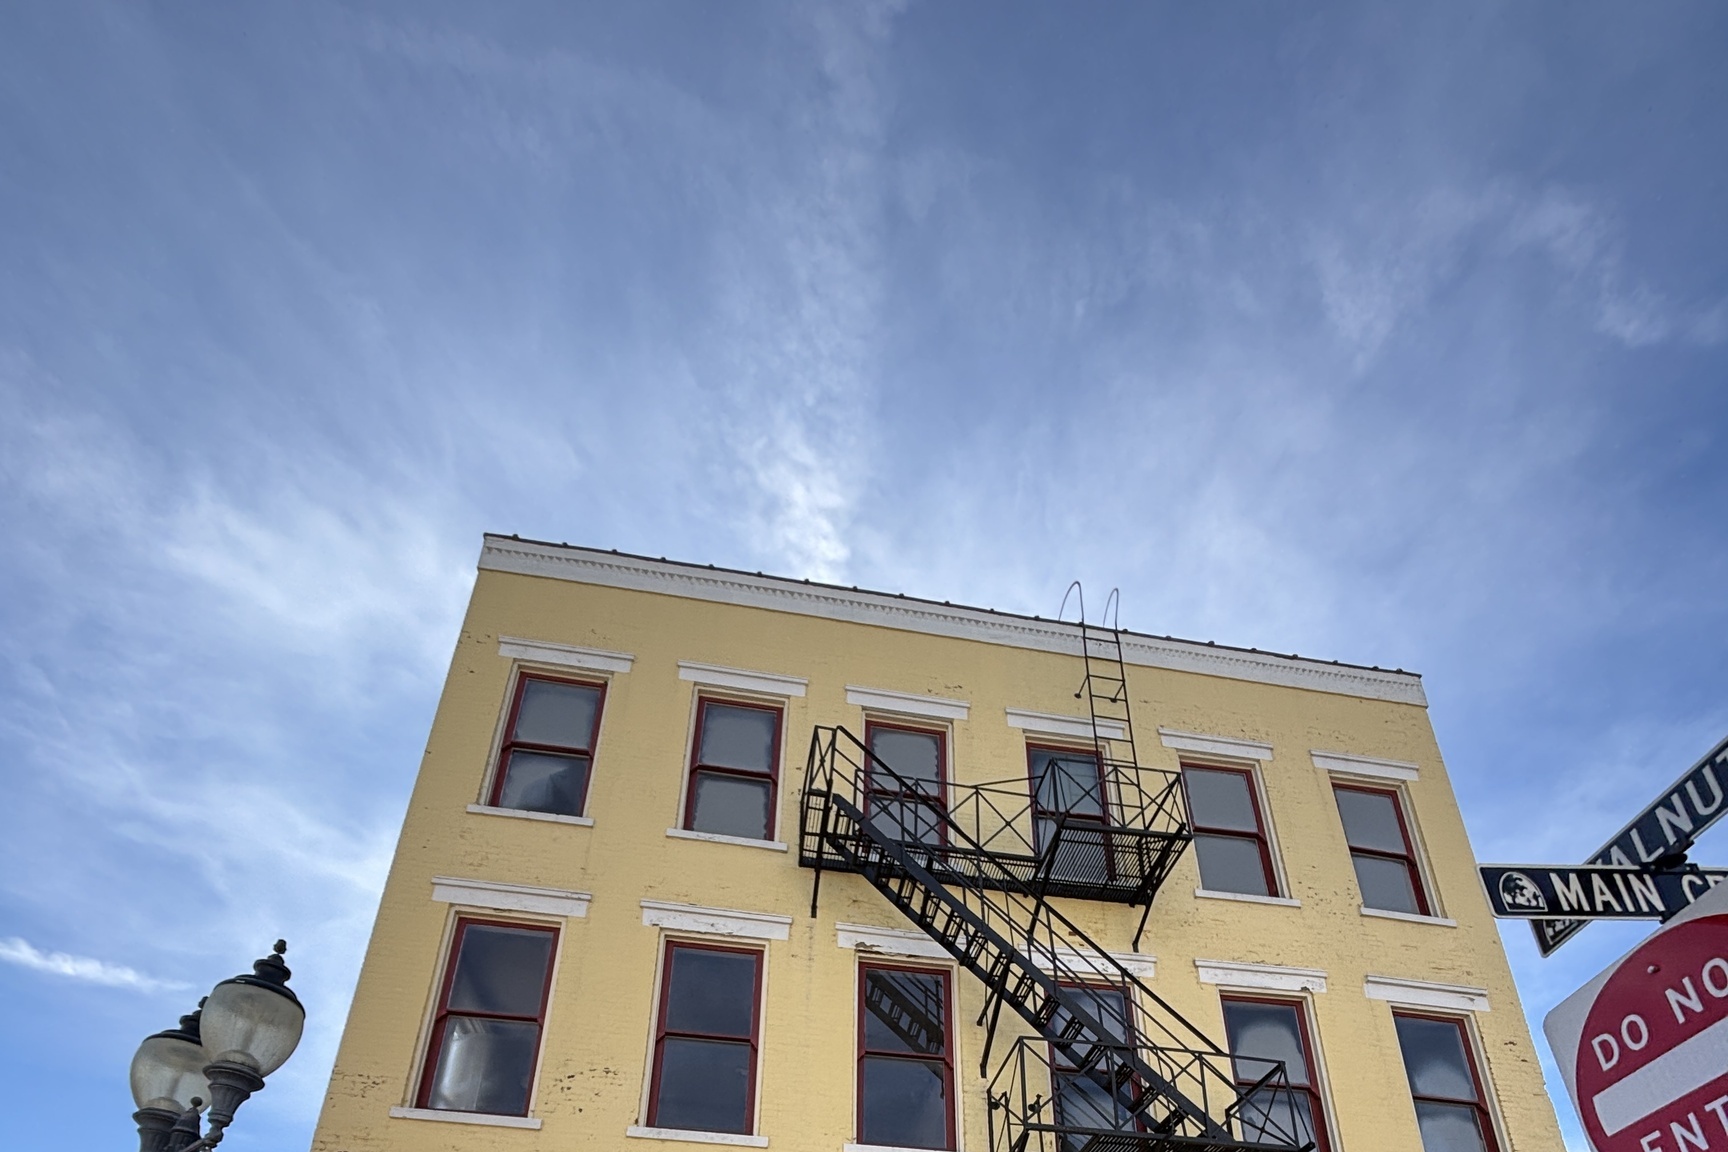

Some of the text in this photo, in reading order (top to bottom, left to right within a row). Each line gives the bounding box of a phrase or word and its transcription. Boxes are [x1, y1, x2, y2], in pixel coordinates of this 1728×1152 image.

[1597, 747, 1728, 866] ALNU
[1549, 872, 1666, 912] MAIN
[1591, 1014, 1649, 1072] DO
